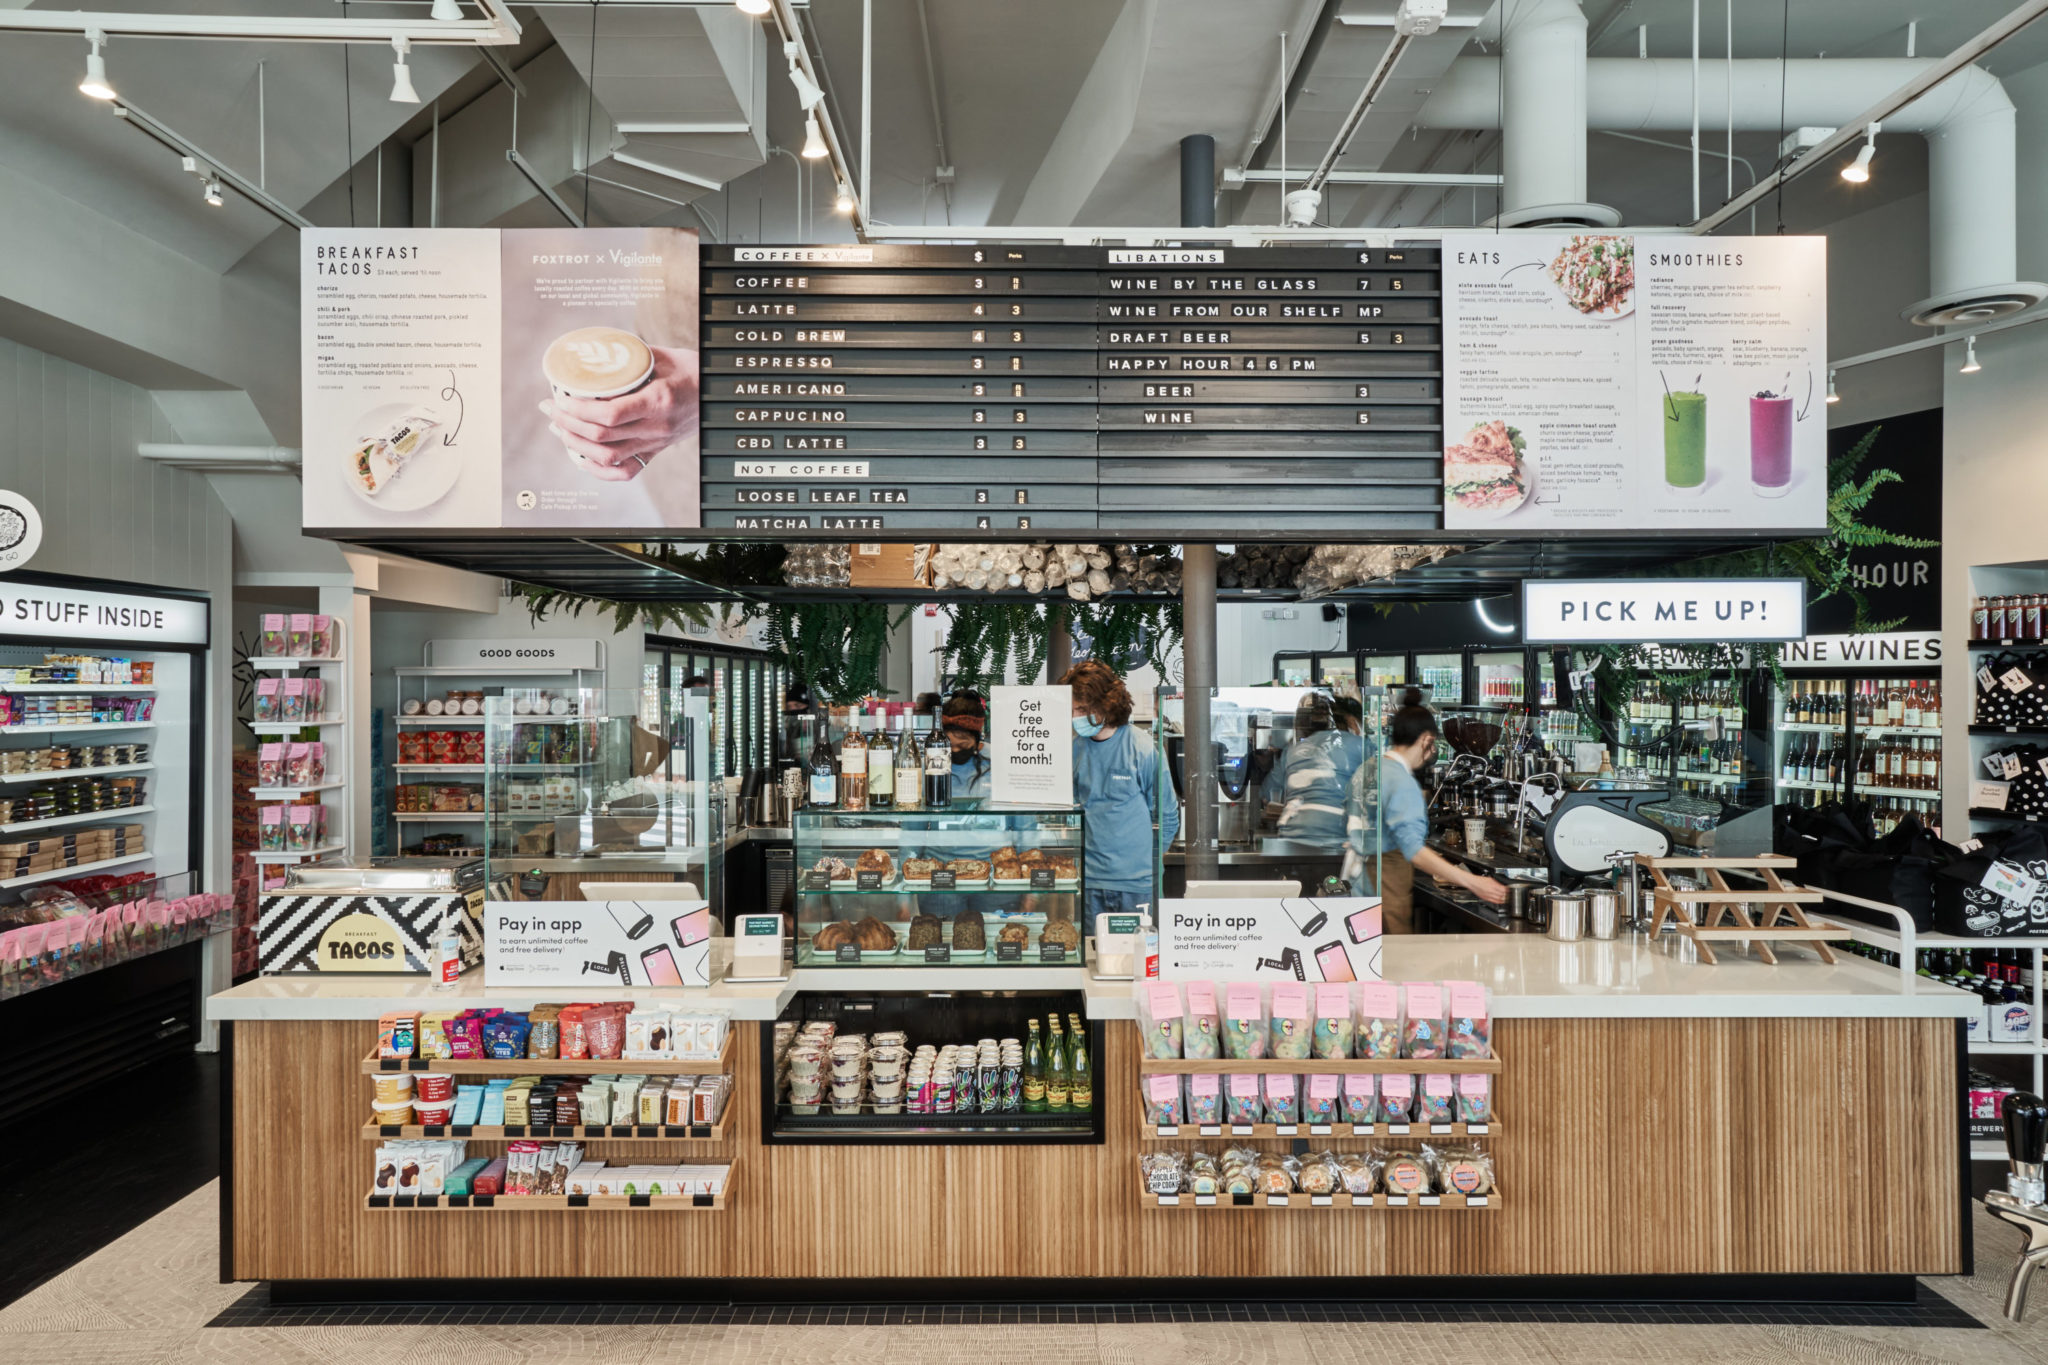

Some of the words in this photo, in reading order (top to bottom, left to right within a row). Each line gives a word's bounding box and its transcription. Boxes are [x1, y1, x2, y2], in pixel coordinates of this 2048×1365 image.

[318, 247, 418, 259] BREAKFAST
[533, 256, 589, 264] FOXTROT
[609, 249, 662, 267] Vigilante
[742, 252, 814, 260] COFFEE
[974, 251, 982, 262] $
[1117, 254, 1217, 263] LIBATIONS
[1360, 252, 1369, 264] $
[1458, 253, 1500, 264] EATS
[1650, 254, 1743, 266] SMOOTHIES
[318, 263, 371, 275] TACOS
[736, 278, 806, 288] COFFEE
[975, 279, 982, 288] 3
[1111, 280, 1157, 290] WINE
[1174, 280, 1195, 290] BY
[1210, 280, 1243, 290] THE
[1258, 280, 1316, 290] GLASS
[1361, 281, 1368, 290] 7
[1394, 281, 1401, 290] 5
[737, 305, 794, 315] LATTE
[975, 306, 982, 315] 4
[1012, 306, 1020, 315] 3
[1110, 307, 1156, 316] WINE
[1173, 307, 1219, 316] FROM
[1234, 307, 1267, 317] OUR
[1284, 307, 1340, 317] SHELF
[1360, 307, 1381, 317] MP
[735, 332, 782, 341] COLD
[797, 331, 845, 341] BREW
[974, 332, 982, 341] 4
[1013, 332, 1021, 342] 3
[1110, 333, 1169, 343] DRAFT
[1184, 333, 1228, 343] BEER
[1362, 334, 1369, 343] 5
[1395, 334, 1402, 343] 3
[736, 358, 831, 368] ESPRESSO
[974, 359, 982, 369] 3
[1110, 360, 1168, 369] HAPPY
[1183, 360, 1229, 369] HOUR
[1247, 360, 1254, 369] 4
[1269, 360, 1277, 369] 6
[1293, 360, 1315, 370] PM
[735, 384, 844, 394] AMERICANO
[975, 385, 983, 395] 3
[1146, 387, 1192, 396] BEER
[1360, 387, 1367, 397] 3
[736, 412, 845, 421] CAPPUCINO
[975, 412, 983, 422] 3
[1016, 412, 1024, 422] 3
[1145, 413, 1192, 423] WINE
[1360, 414, 1368, 424] 5
[391, 427, 411, 444] TACOS
[737, 438, 771, 448] CBD
[786, 438, 844, 448] LATTE
[976, 439, 984, 449] 3
[1016, 439, 1023, 449] 3
[741, 466, 776, 474] NOT
[790, 465, 863, 474] COFFEE
[738, 492, 796, 502] LOOSE
[812, 492, 856, 502] LEAF
[872, 492, 906, 502] TEA
[978, 492, 986, 502] 3
[736, 519, 807, 529] MATCHA
[824, 520, 880, 529] LATTE
[980, 520, 987, 529] 4
[1021, 520, 1028, 529] 3
[1853, 560, 1929, 588] HOUR
[15, 599, 89, 624] STUFF
[98, 606, 164, 629] INSIDE
[1561, 601, 1636, 621] PICK
[1655, 601, 1698, 620] ME
[1715, 600, 1767, 620] UP!
[480, 649, 512, 658] GOOD
[516, 650, 555, 658] GOODS
[1782, 642, 1827, 661] INE
[1840, 638, 1942, 661] WINES
[1020, 700, 1041, 711] Get
[1019, 713, 1042, 724] free
[1012, 726, 1049, 738] coffee
[1017, 739, 1034, 751] for
[1010, 754, 1052, 764] month!
[500, 917, 528, 934] Pay
[532, 917, 545, 930] in
[551, 919, 582, 934] app
[1174, 914, 1203, 931] Pay
[1208, 914, 1220, 927] in
[1226, 916, 1257, 931] app
[328, 941, 394, 959] TACOS
[533, 946, 562, 954] delivery
[1207, 943, 1237, 952] delivery
[619, 957, 630, 983] DELIVERY
[1293, 954, 1303, 980] DELIVERY
[1150, 1173, 1178, 1181] CHOCOLATE
